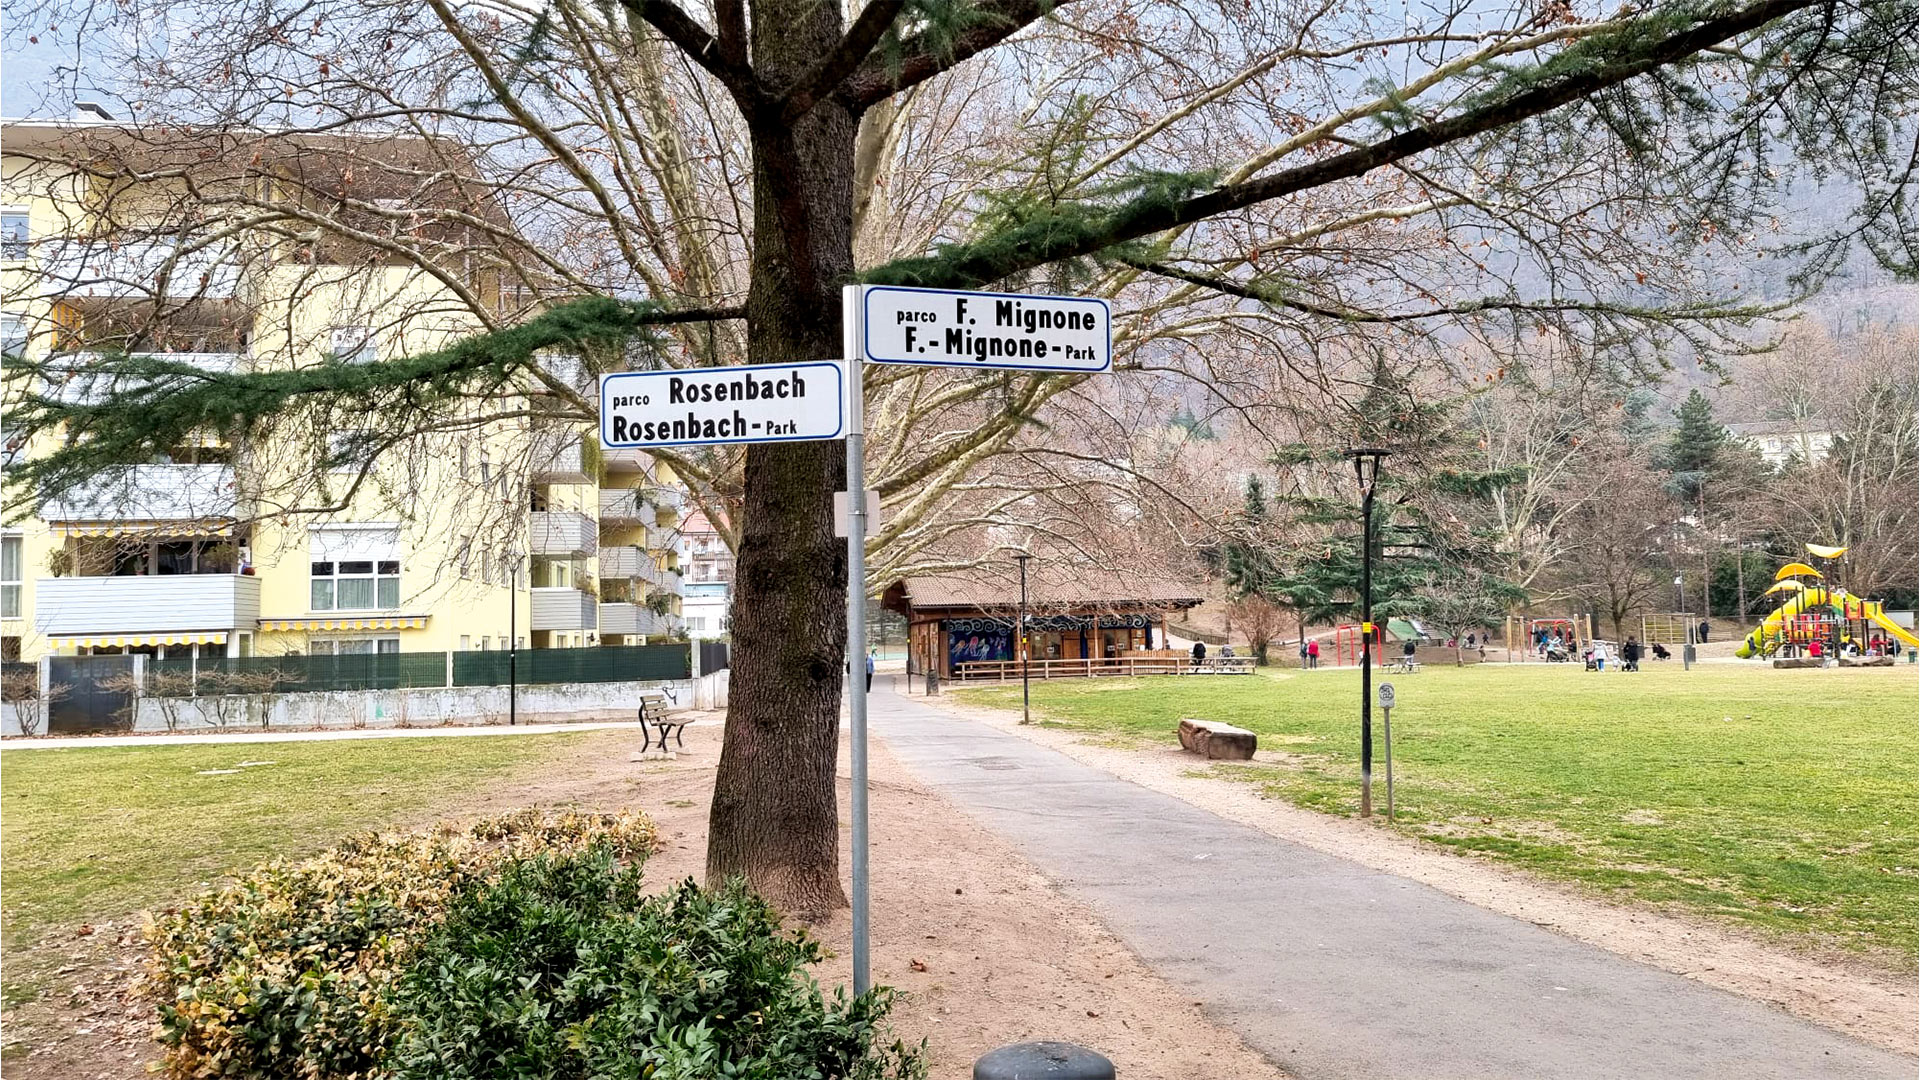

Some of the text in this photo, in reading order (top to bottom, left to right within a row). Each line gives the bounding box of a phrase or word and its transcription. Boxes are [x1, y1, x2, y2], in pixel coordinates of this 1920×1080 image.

[896, 297, 1096, 334] parco F. Mignone
[613, 370, 805, 411] parco Rosenbach
